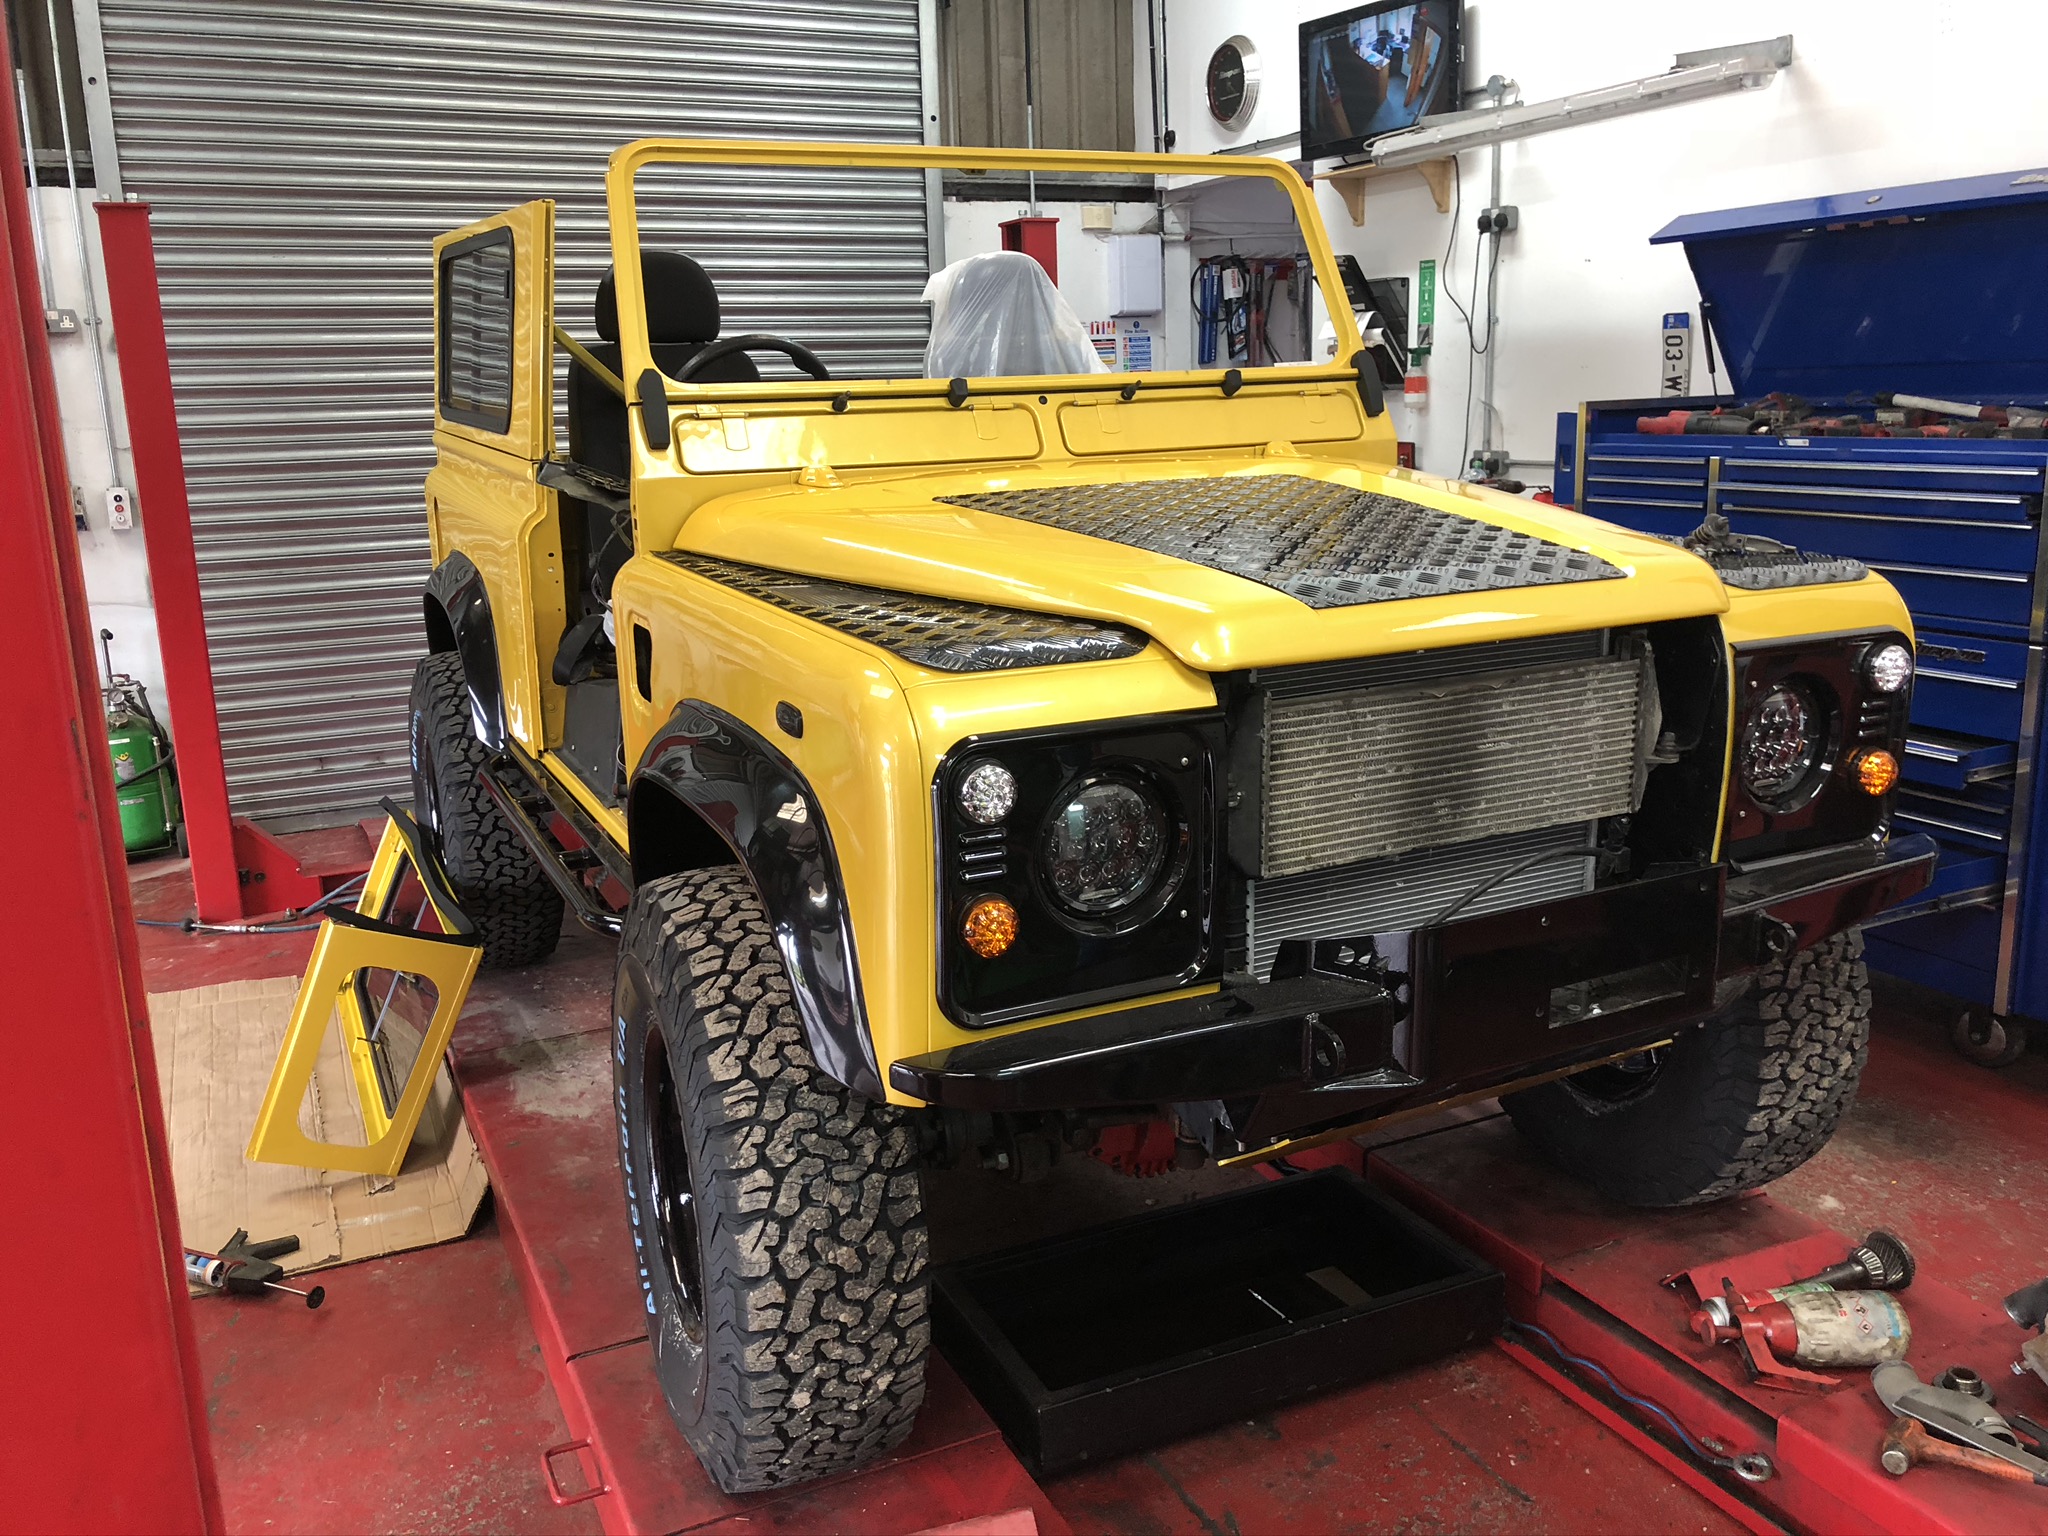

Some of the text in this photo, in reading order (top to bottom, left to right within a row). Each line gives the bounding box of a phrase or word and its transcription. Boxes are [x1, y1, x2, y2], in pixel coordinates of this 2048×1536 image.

[1667, 315, 1675, 329] IRL
[1664, 335, 1683, 397] 03-W
[617, 1015, 657, 1315] All-Terrain T/A
